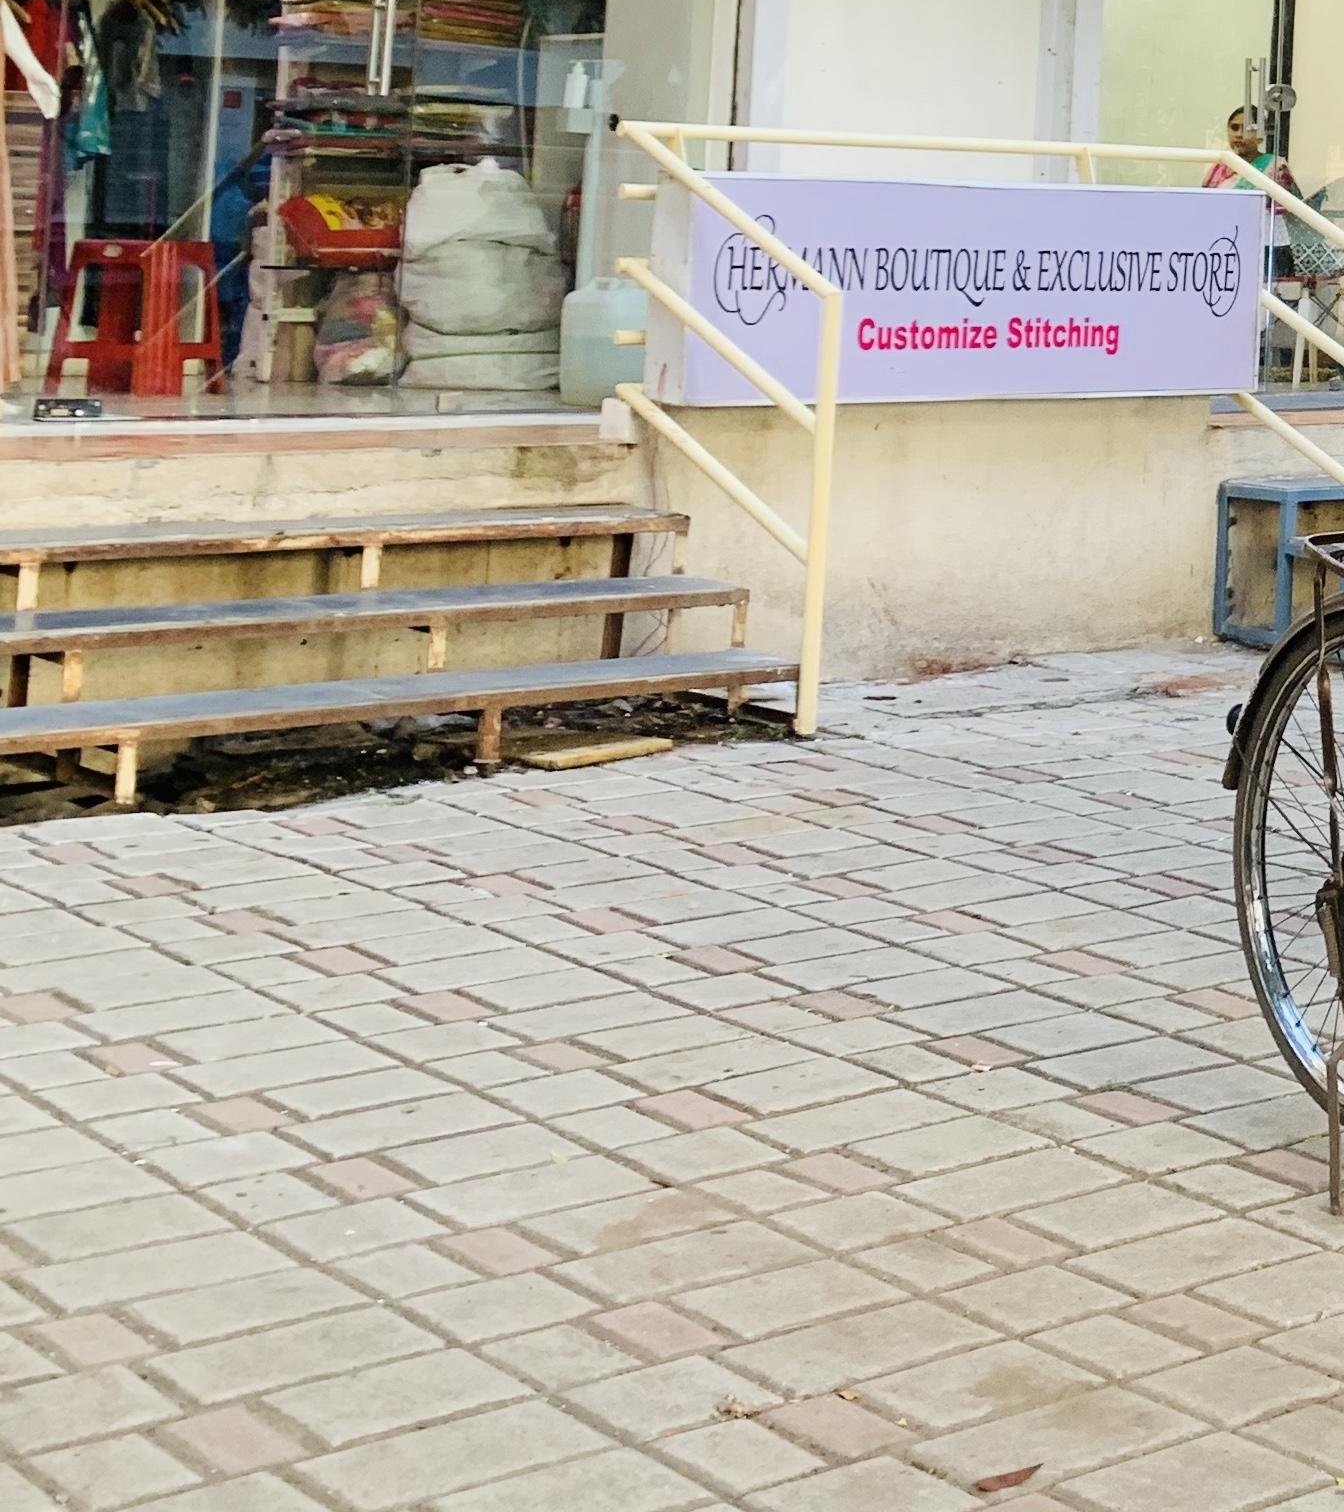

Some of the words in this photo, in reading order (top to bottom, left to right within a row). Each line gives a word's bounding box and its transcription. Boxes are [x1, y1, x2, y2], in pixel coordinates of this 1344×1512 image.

[874, 246, 1007, 306] BOUTIQUE
[1014, 249, 1031, 290] &
[1037, 250, 1162, 292] EXCLUSIVE
[1167, 226, 1240, 317] STORE
[857, 318, 998, 351] Customize
[1006, 317, 1120, 355] Stitching
